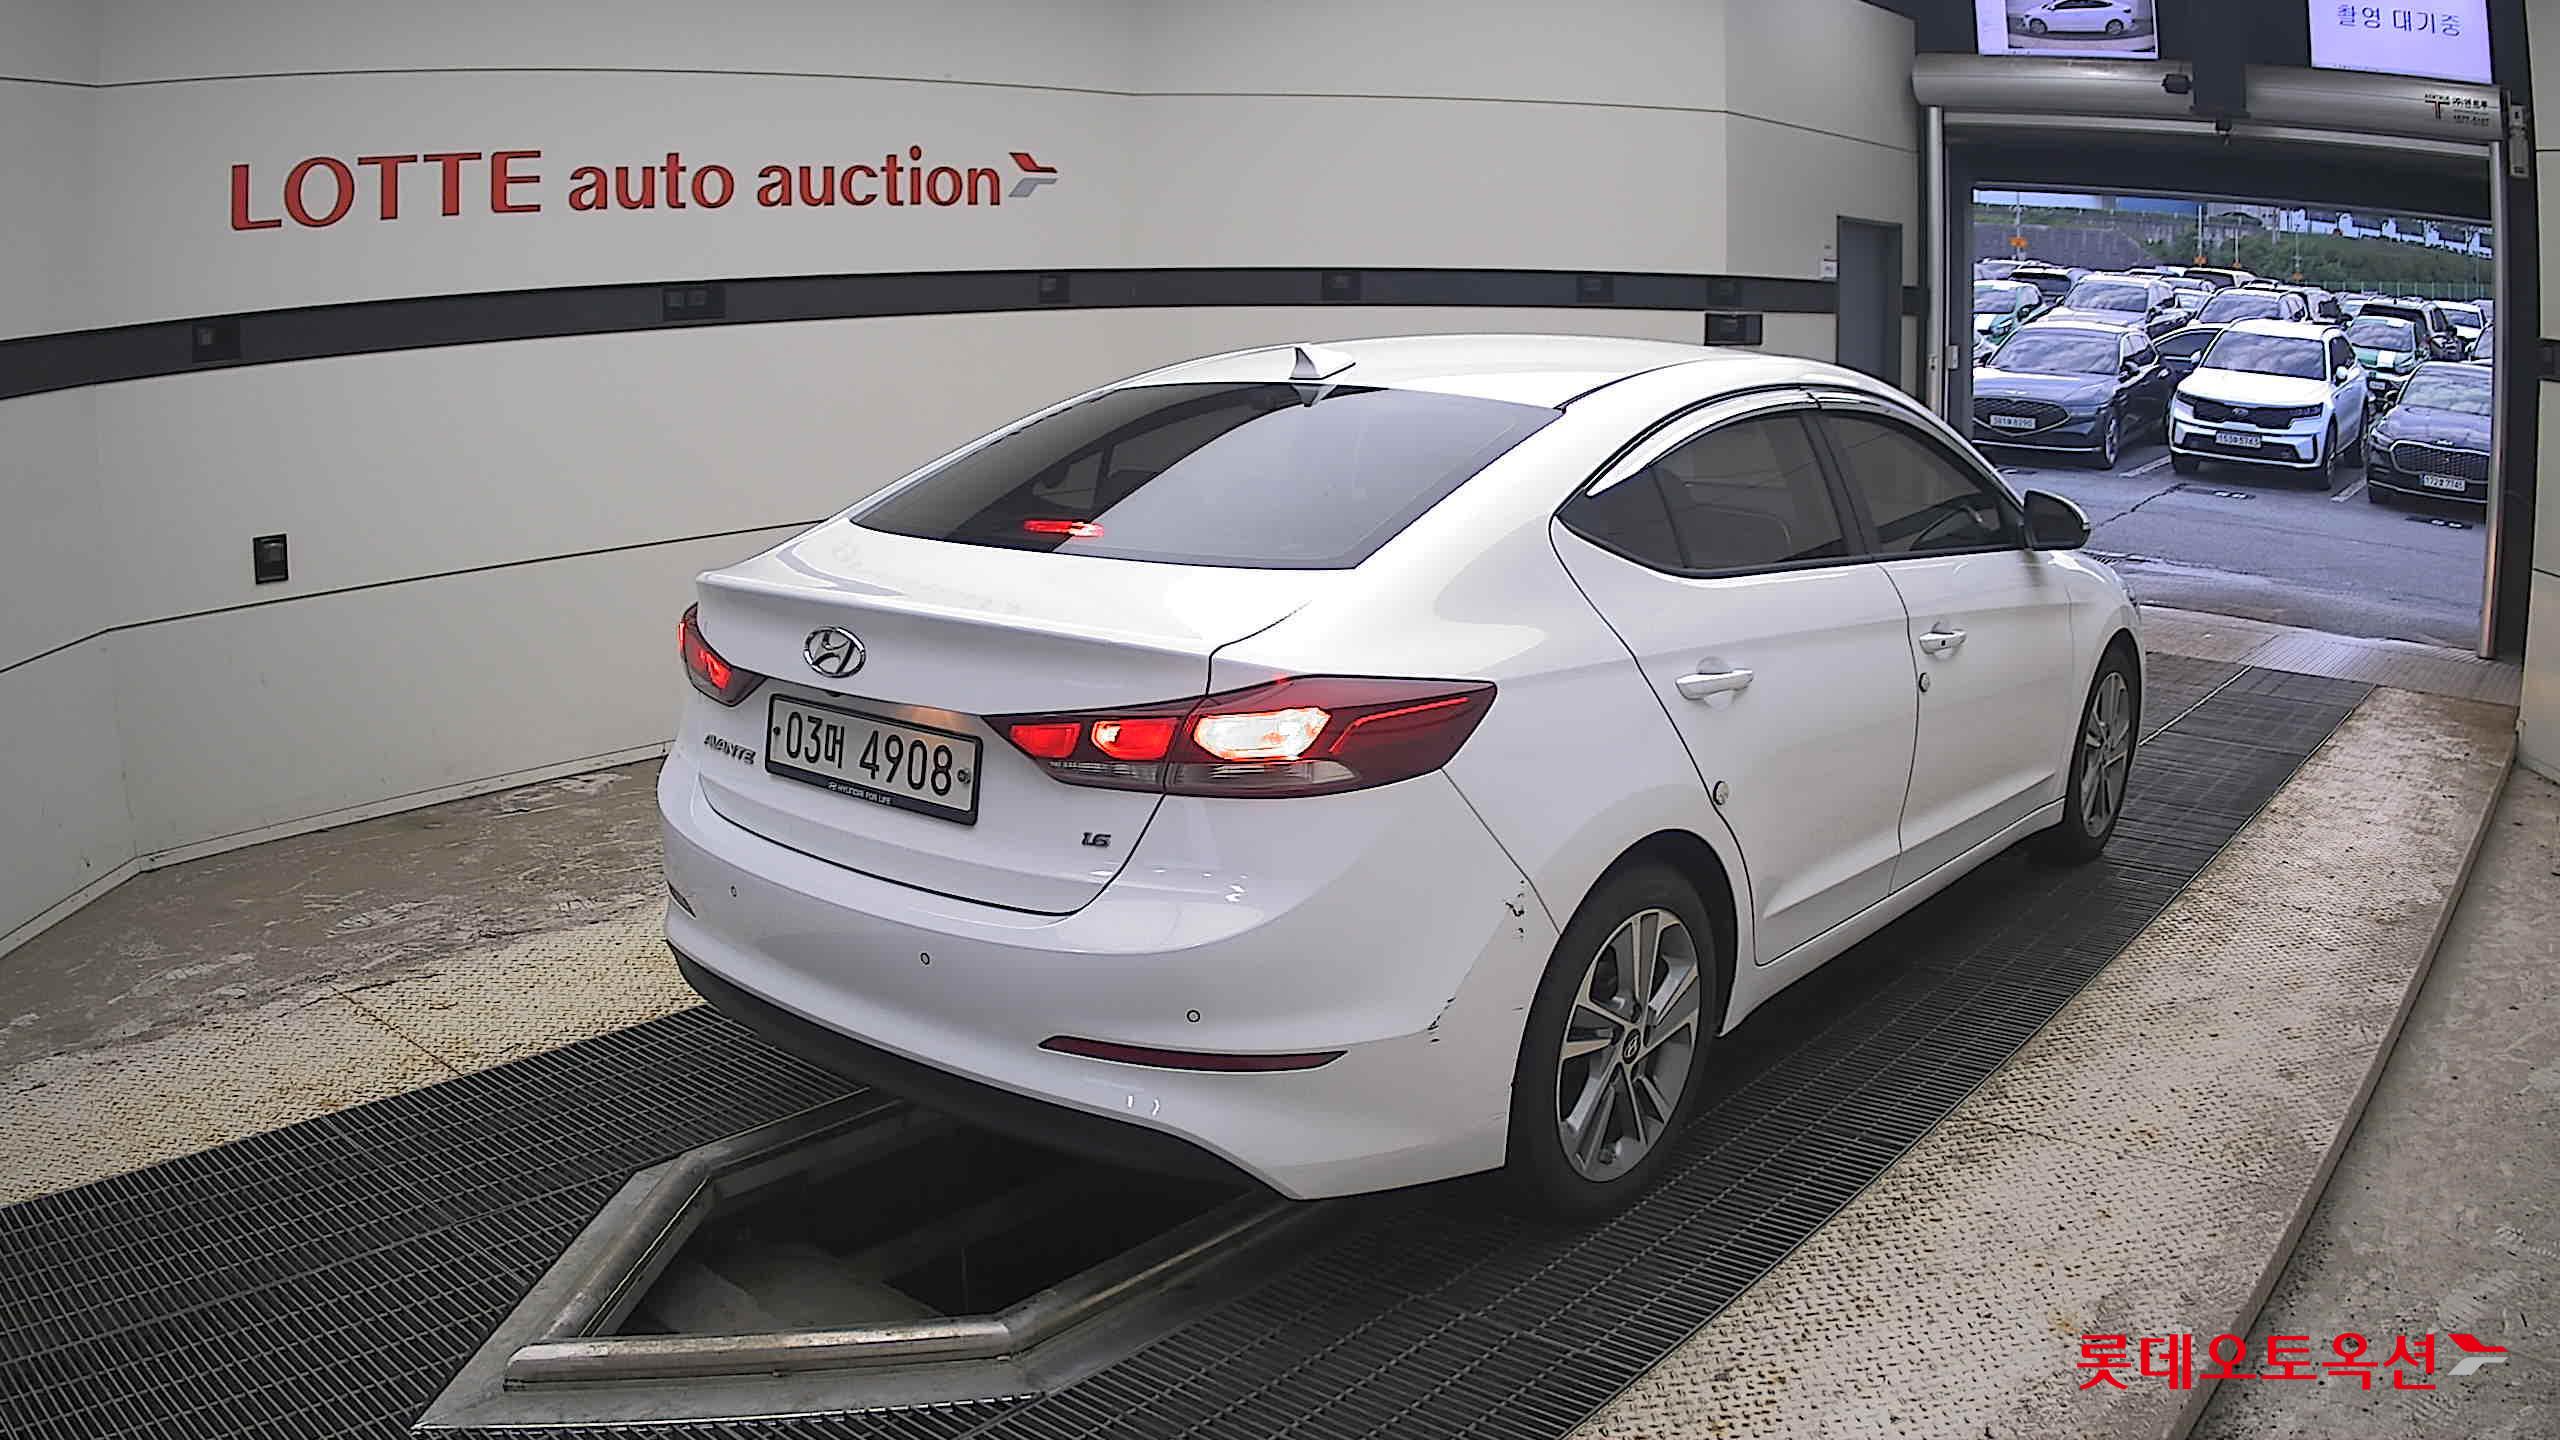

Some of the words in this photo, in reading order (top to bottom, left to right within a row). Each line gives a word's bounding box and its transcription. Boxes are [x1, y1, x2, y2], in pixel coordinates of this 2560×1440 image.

[2337, 4, 2381, 29] 촬영
[2392, 9, 2461, 37] 대기중
[231, 149, 543, 232] LOTTE
[568, 152, 735, 210] auto
[757, 145, 1003, 208] auction
[704, 734, 757, 765] AVANTE
[786, 711, 846, 770] 03머
[859, 729, 954, 797] 4908
